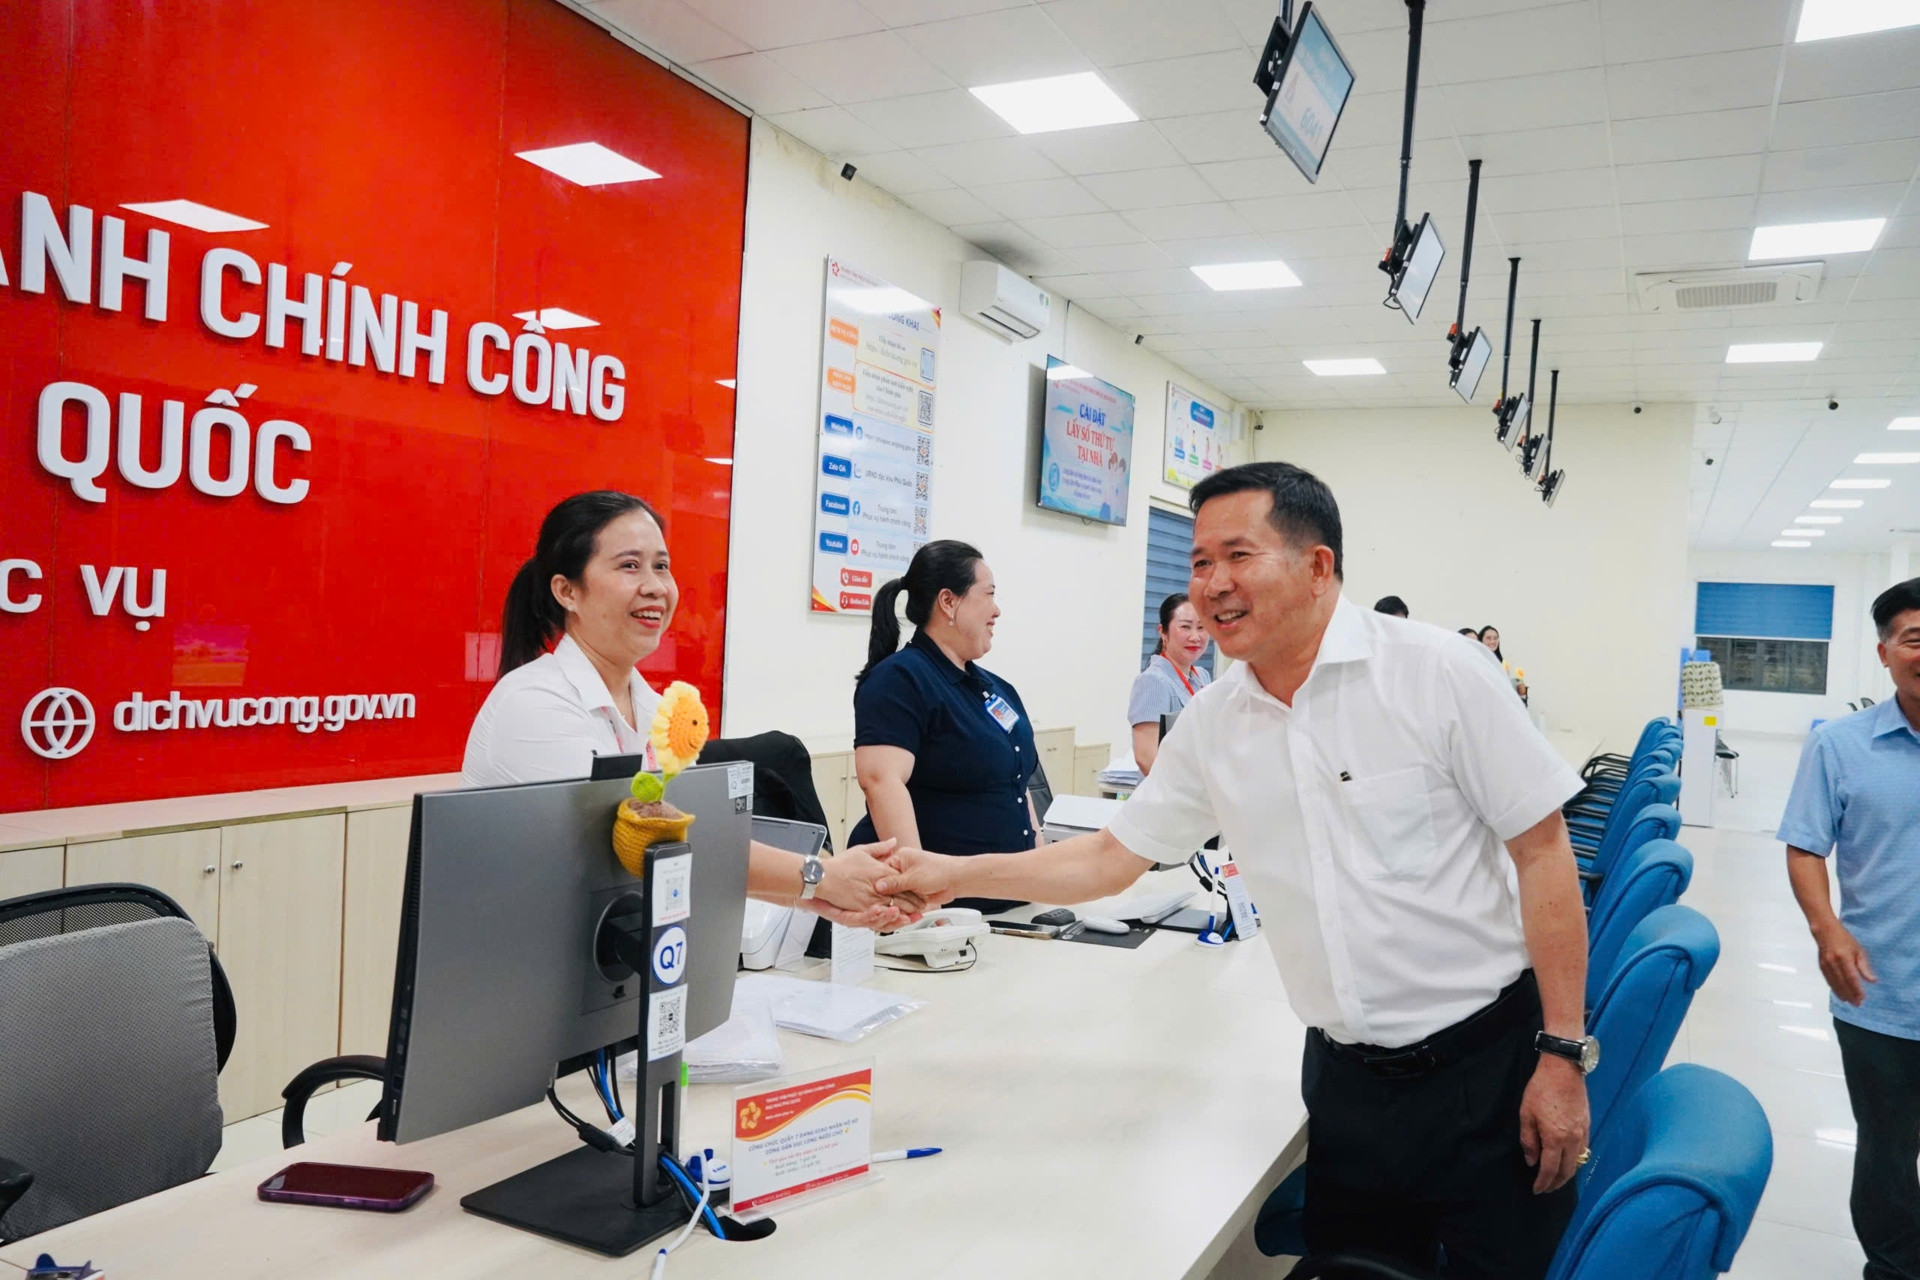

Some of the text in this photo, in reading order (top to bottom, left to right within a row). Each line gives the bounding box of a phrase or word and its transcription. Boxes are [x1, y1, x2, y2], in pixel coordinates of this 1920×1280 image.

[0, 190, 626, 422] NH CHÍNH CÔNG
[37, 383, 312, 504] QUỐC
[1081, 423, 1090, 442] SỐ
[829, 462, 838, 471] Zalo
[825, 500, 846, 510] Facebook
[80, 564, 168, 632] vụ
[659, 941, 683, 970] Q7
